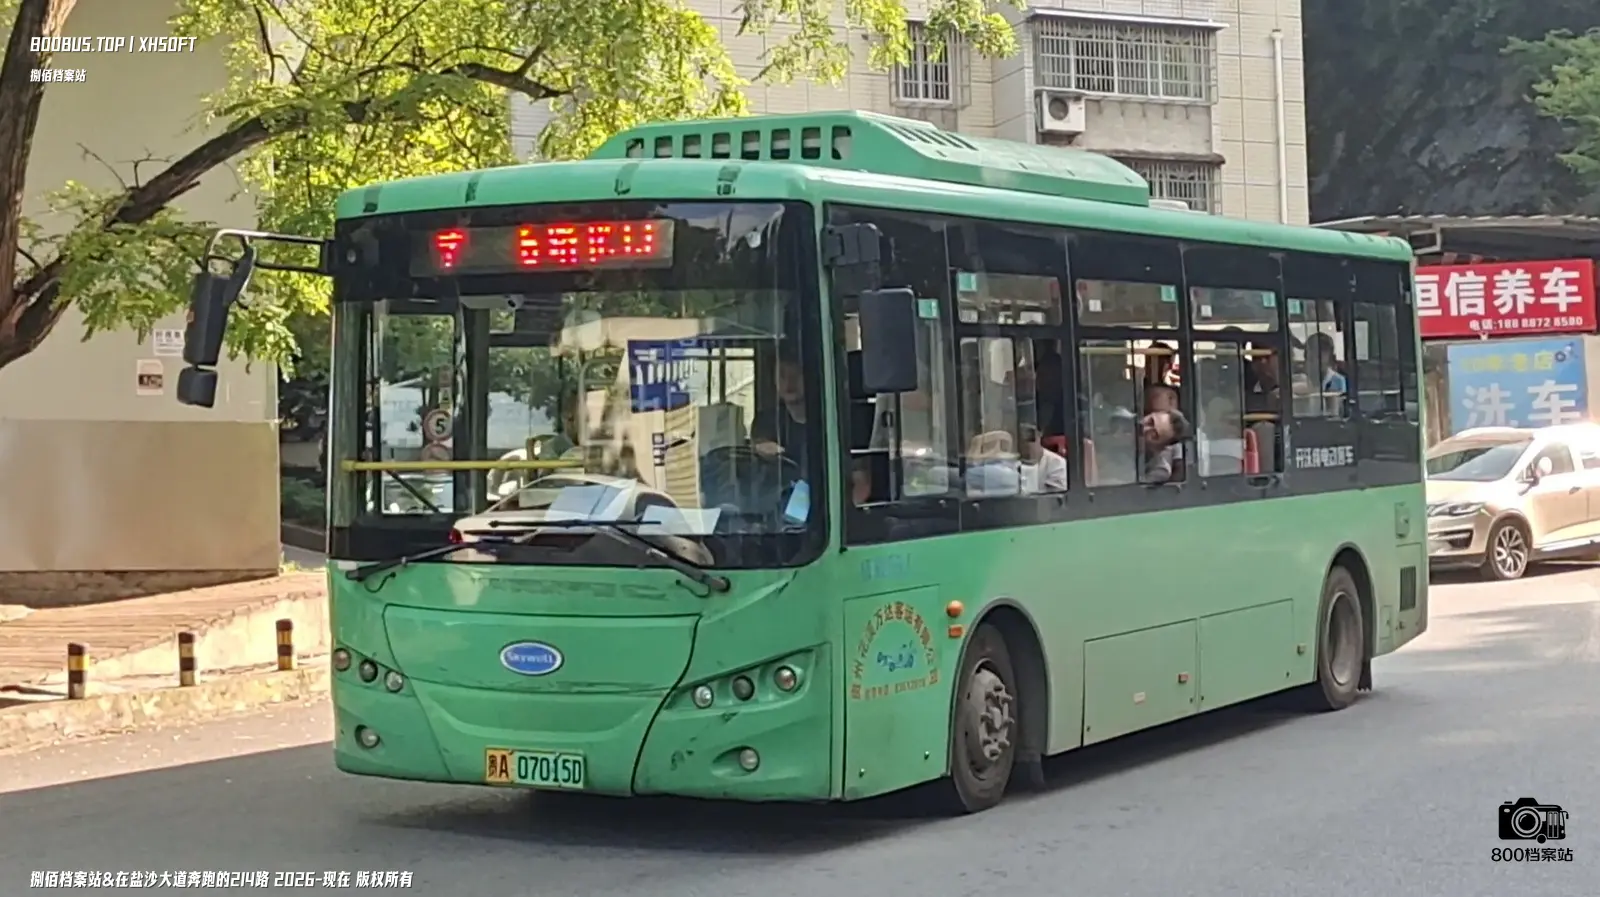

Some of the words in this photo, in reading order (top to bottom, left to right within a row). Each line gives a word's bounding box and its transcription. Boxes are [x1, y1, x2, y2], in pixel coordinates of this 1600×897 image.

[1414, 266, 1583, 317] 恒信养车
[1462, 379, 1581, 428] 洗车
[434, 418, 446, 434] 5
[517, 755, 582, 785] 07015D
